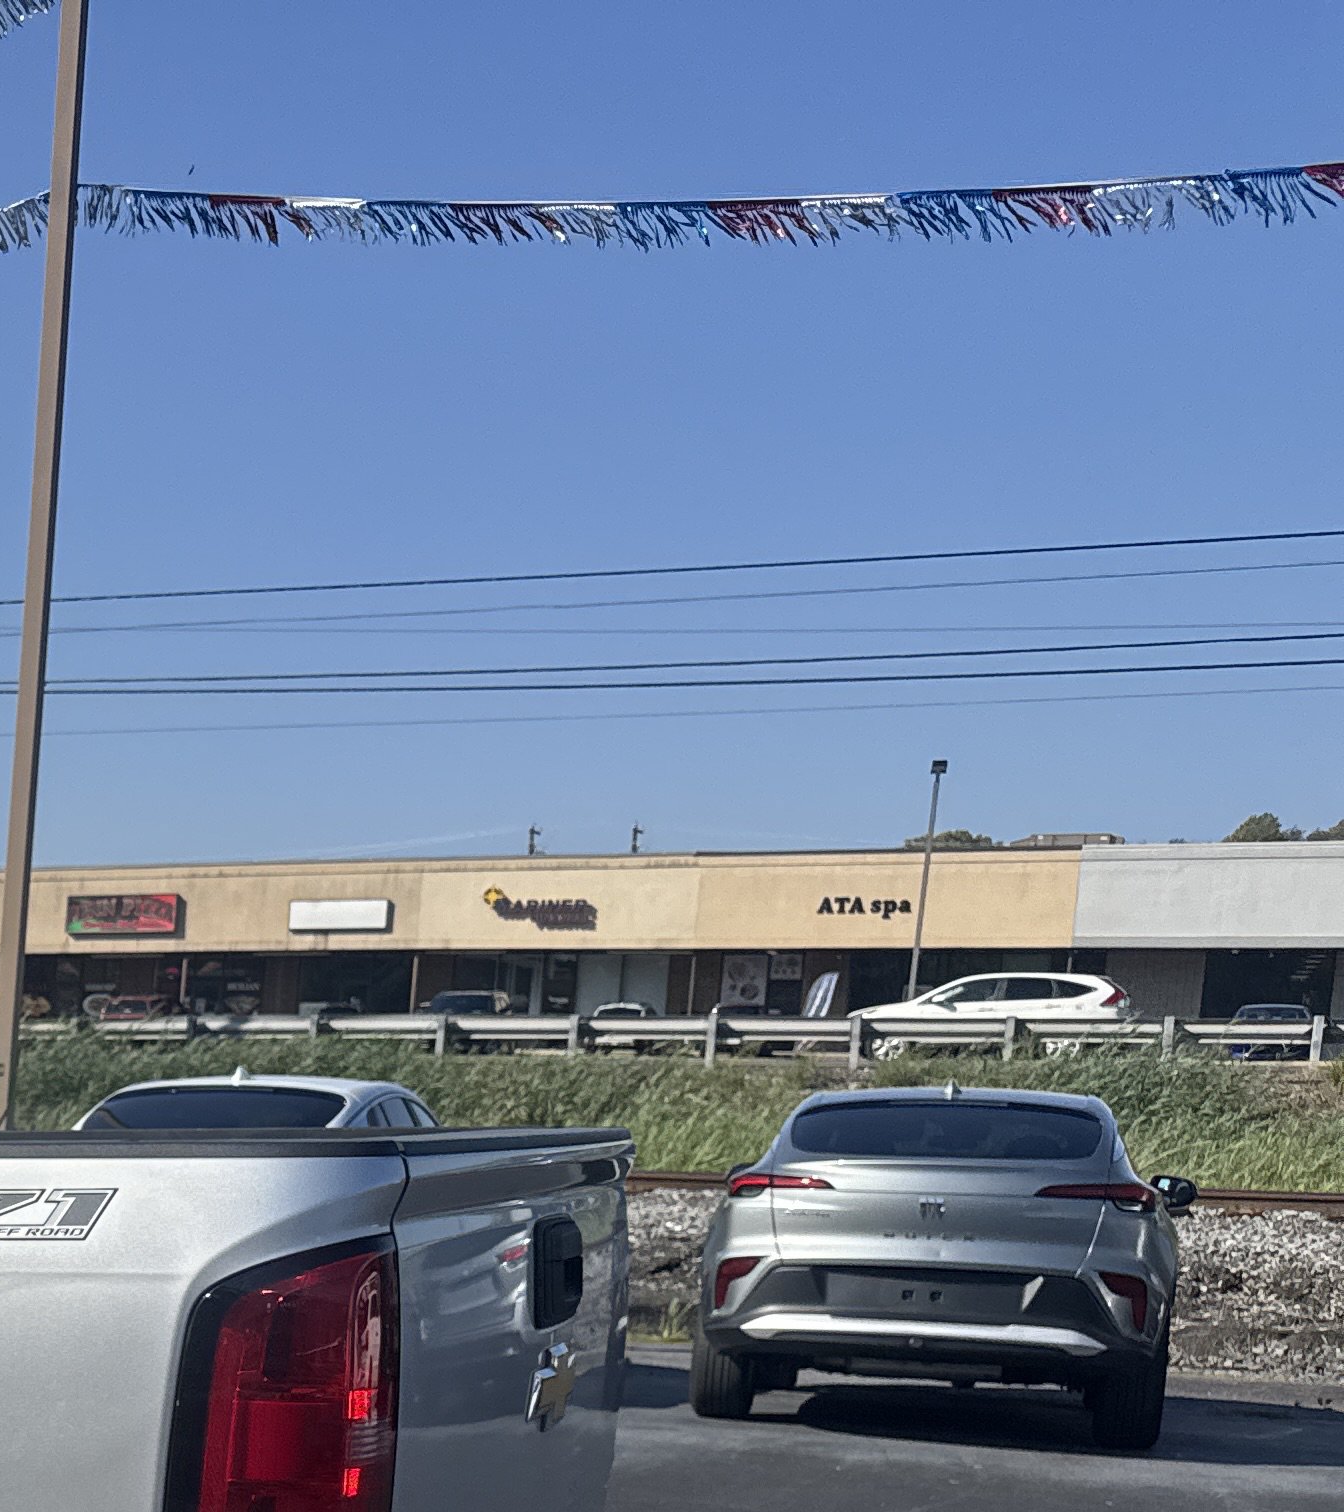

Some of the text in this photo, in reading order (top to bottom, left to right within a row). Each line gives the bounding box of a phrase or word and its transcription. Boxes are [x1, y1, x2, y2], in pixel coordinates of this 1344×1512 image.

[816, 896, 913, 920] ATA spa
[26, 1228, 86, 1237] ROAD
